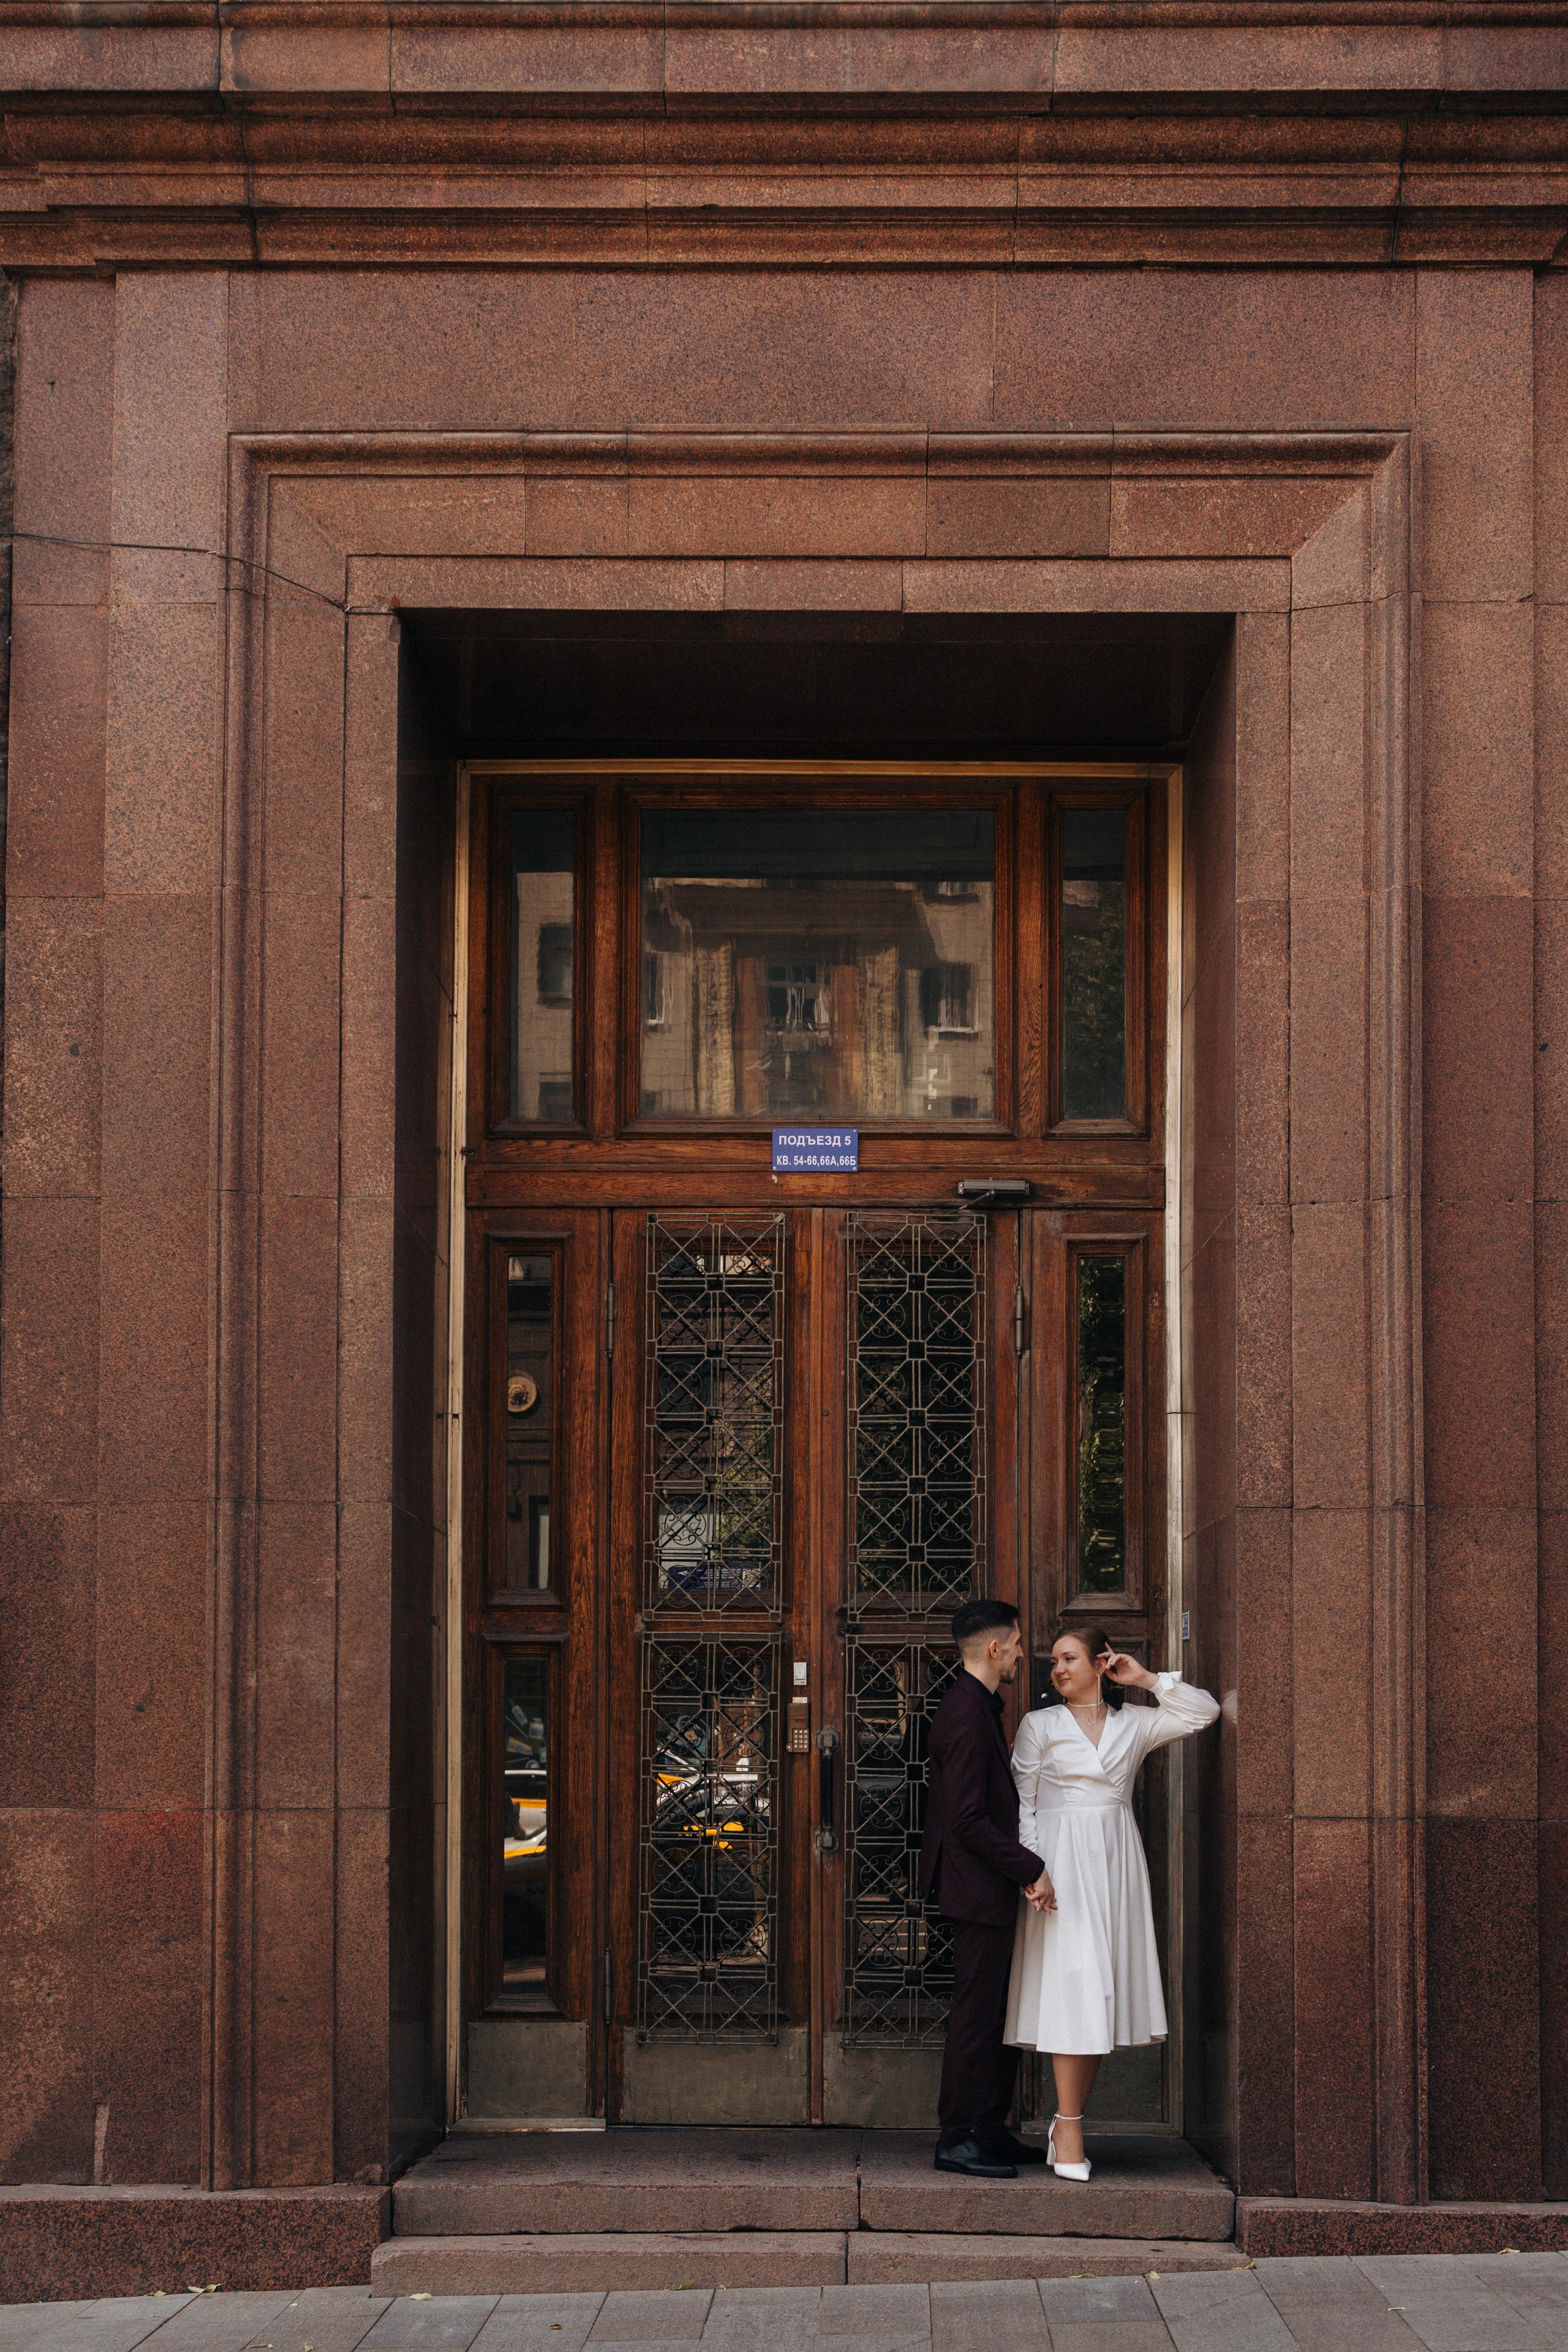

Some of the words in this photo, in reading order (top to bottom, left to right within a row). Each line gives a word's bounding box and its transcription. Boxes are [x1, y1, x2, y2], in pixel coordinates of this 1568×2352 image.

[778, 1135, 841, 1147] ПОДЪЕЗД
[844, 1136, 851, 1145] 5
[777, 1155, 791, 1166] КВ.
